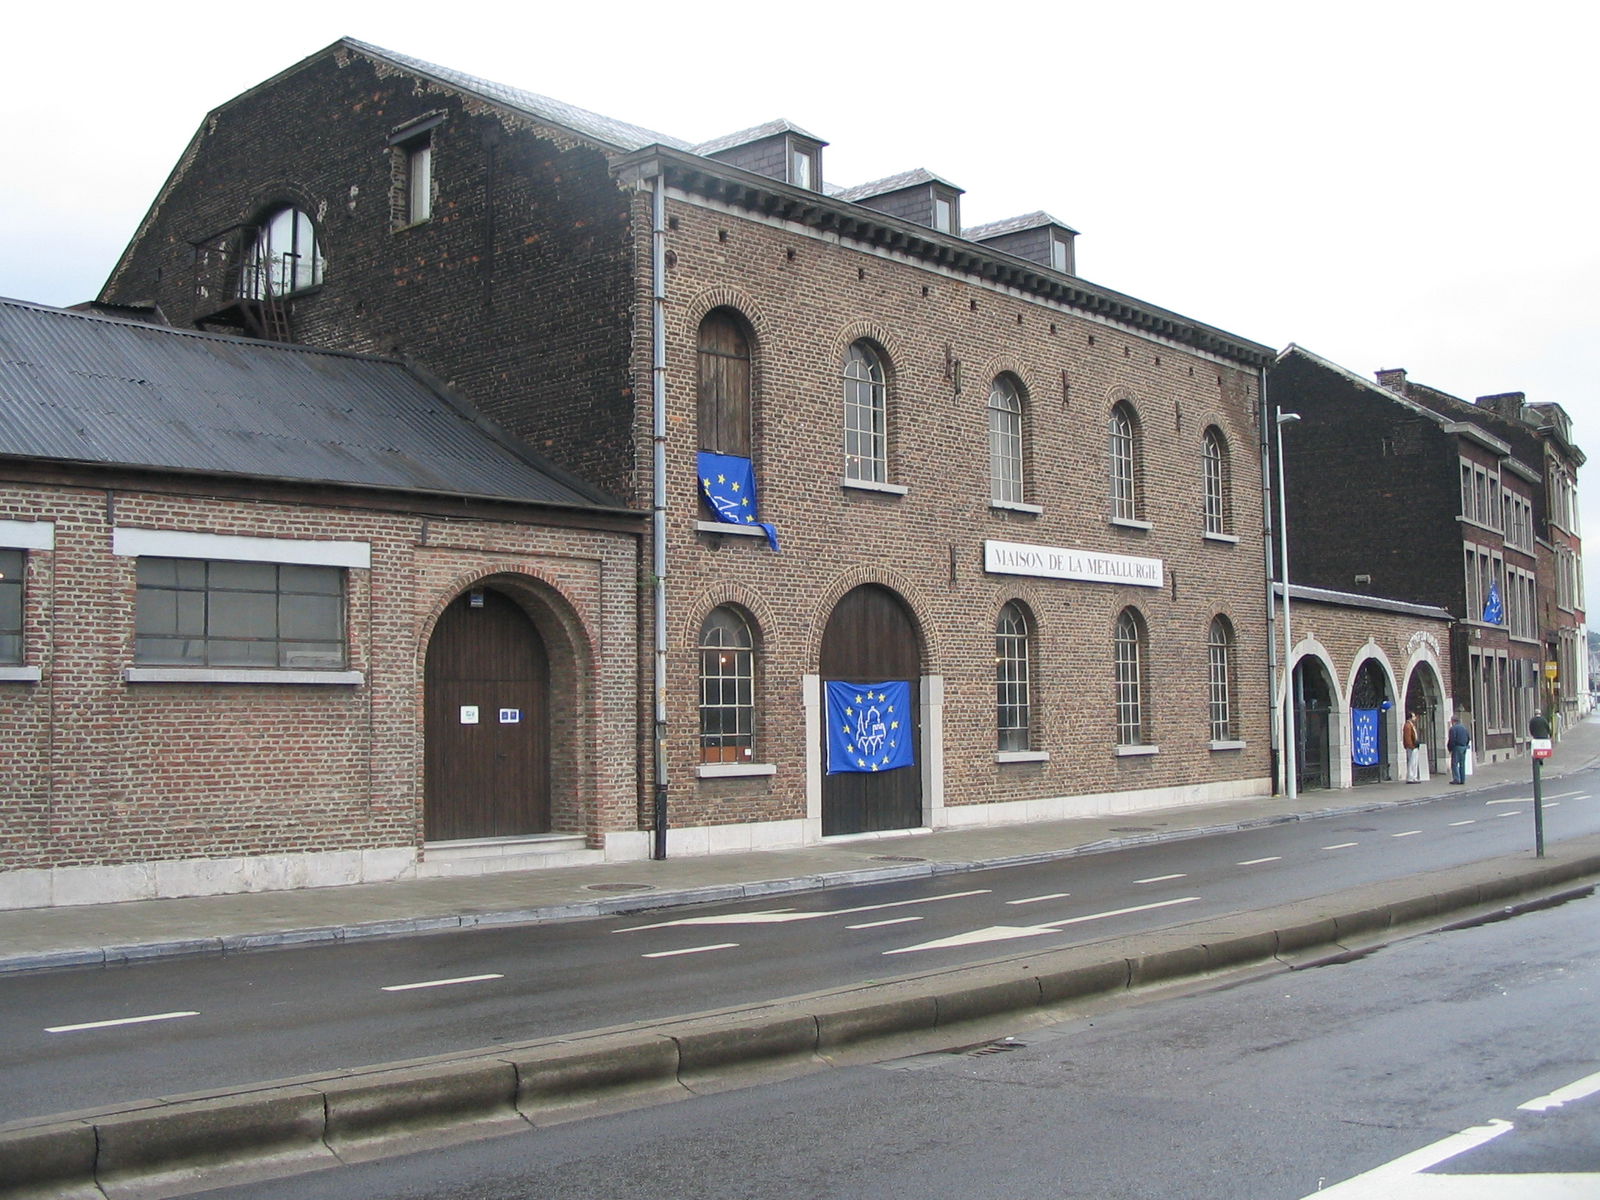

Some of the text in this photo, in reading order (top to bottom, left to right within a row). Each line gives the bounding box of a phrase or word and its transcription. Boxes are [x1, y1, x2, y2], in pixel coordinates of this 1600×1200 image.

[994, 549, 1158, 580] MAISON DE LA METALLURGIE
